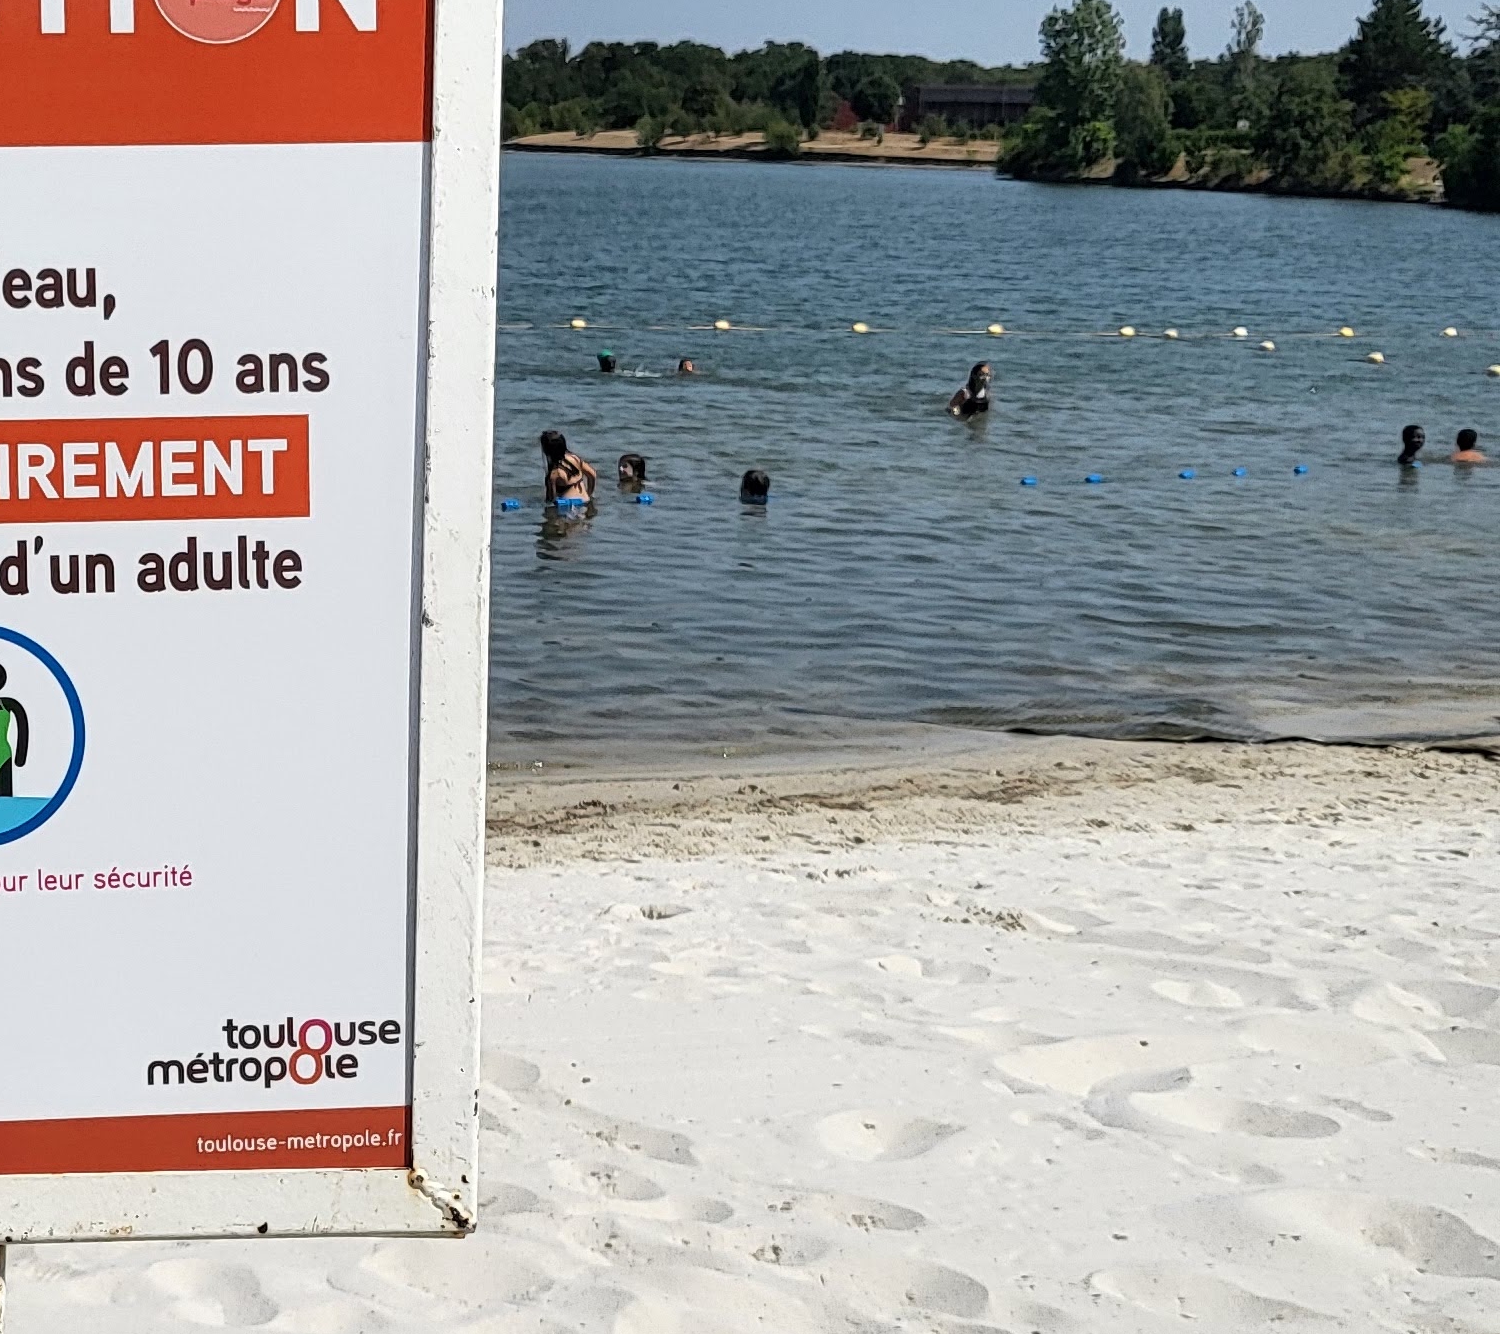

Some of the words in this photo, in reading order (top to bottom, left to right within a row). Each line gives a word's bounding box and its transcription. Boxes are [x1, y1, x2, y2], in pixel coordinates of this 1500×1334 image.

[65, 341, 130, 397] de
[149, 338, 214, 394] 10
[235, 350, 331, 394] ans
[136, 535, 303, 593] adulte
[37, 868, 85, 892] leur
[93, 865, 194, 890] sécurité
[222, 1017, 401, 1054] toulouse
[147, 1050, 359, 1089] métropole
[197, 1128, 403, 1153] toulouse-metropole.fr
